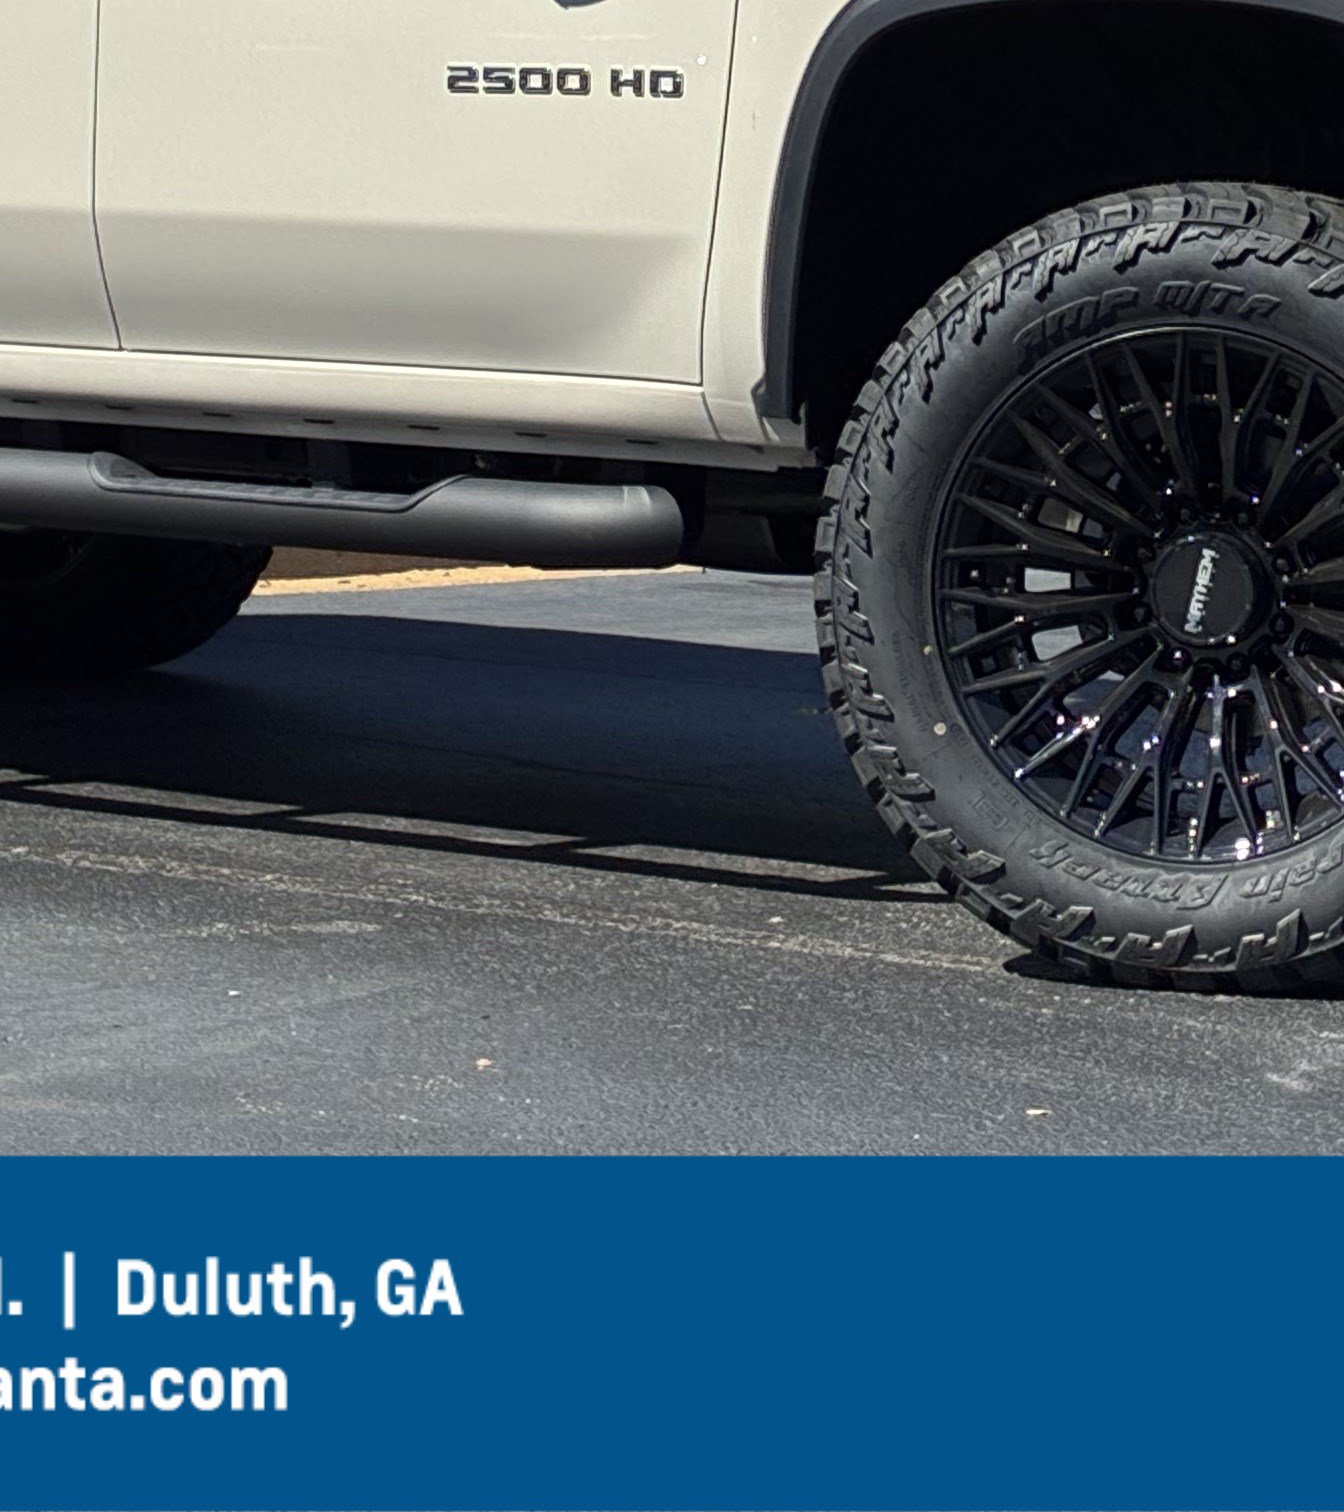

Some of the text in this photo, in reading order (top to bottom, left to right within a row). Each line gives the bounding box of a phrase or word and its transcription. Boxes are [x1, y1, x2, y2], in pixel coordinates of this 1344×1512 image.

[447, 66, 684, 99] 2500 HD
[1184, 548, 1220, 634] MAYHEM
